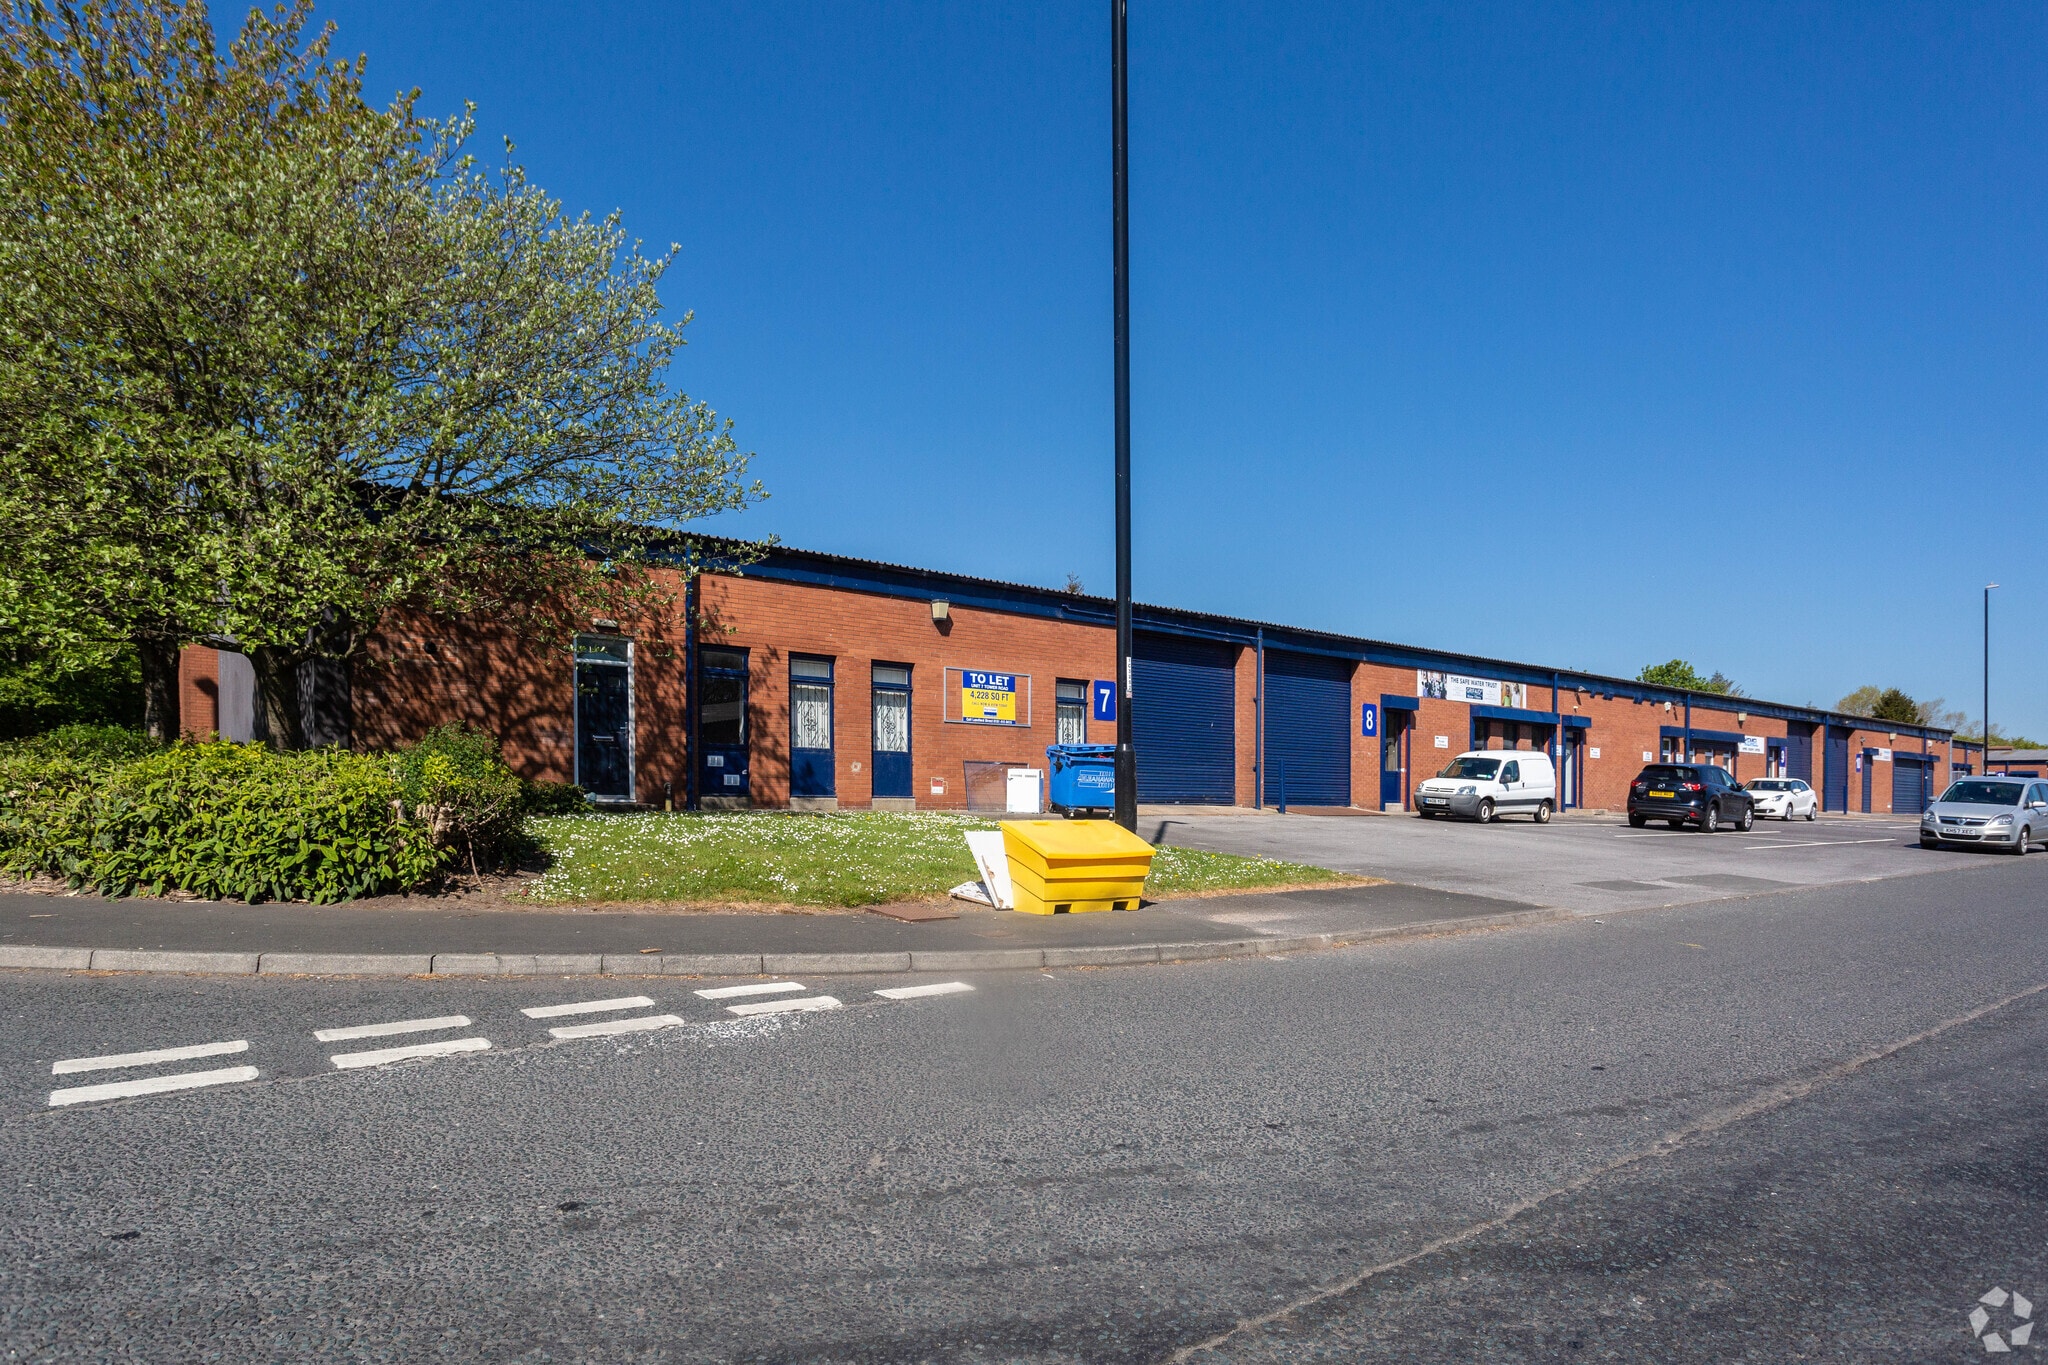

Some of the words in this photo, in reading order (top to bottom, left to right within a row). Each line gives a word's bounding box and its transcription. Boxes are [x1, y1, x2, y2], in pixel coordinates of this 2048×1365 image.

[970, 673, 986, 684] TO
[989, 674, 1009, 686] LET
[1471, 679, 1484, 687] WATER
[1485, 680, 1497, 688] TRUST
[970, 691, 989, 699] 4,228
[991, 692, 999, 700] SQ
[1100, 688, 1110, 712] 7
[1366, 710, 1373, 730] 8
